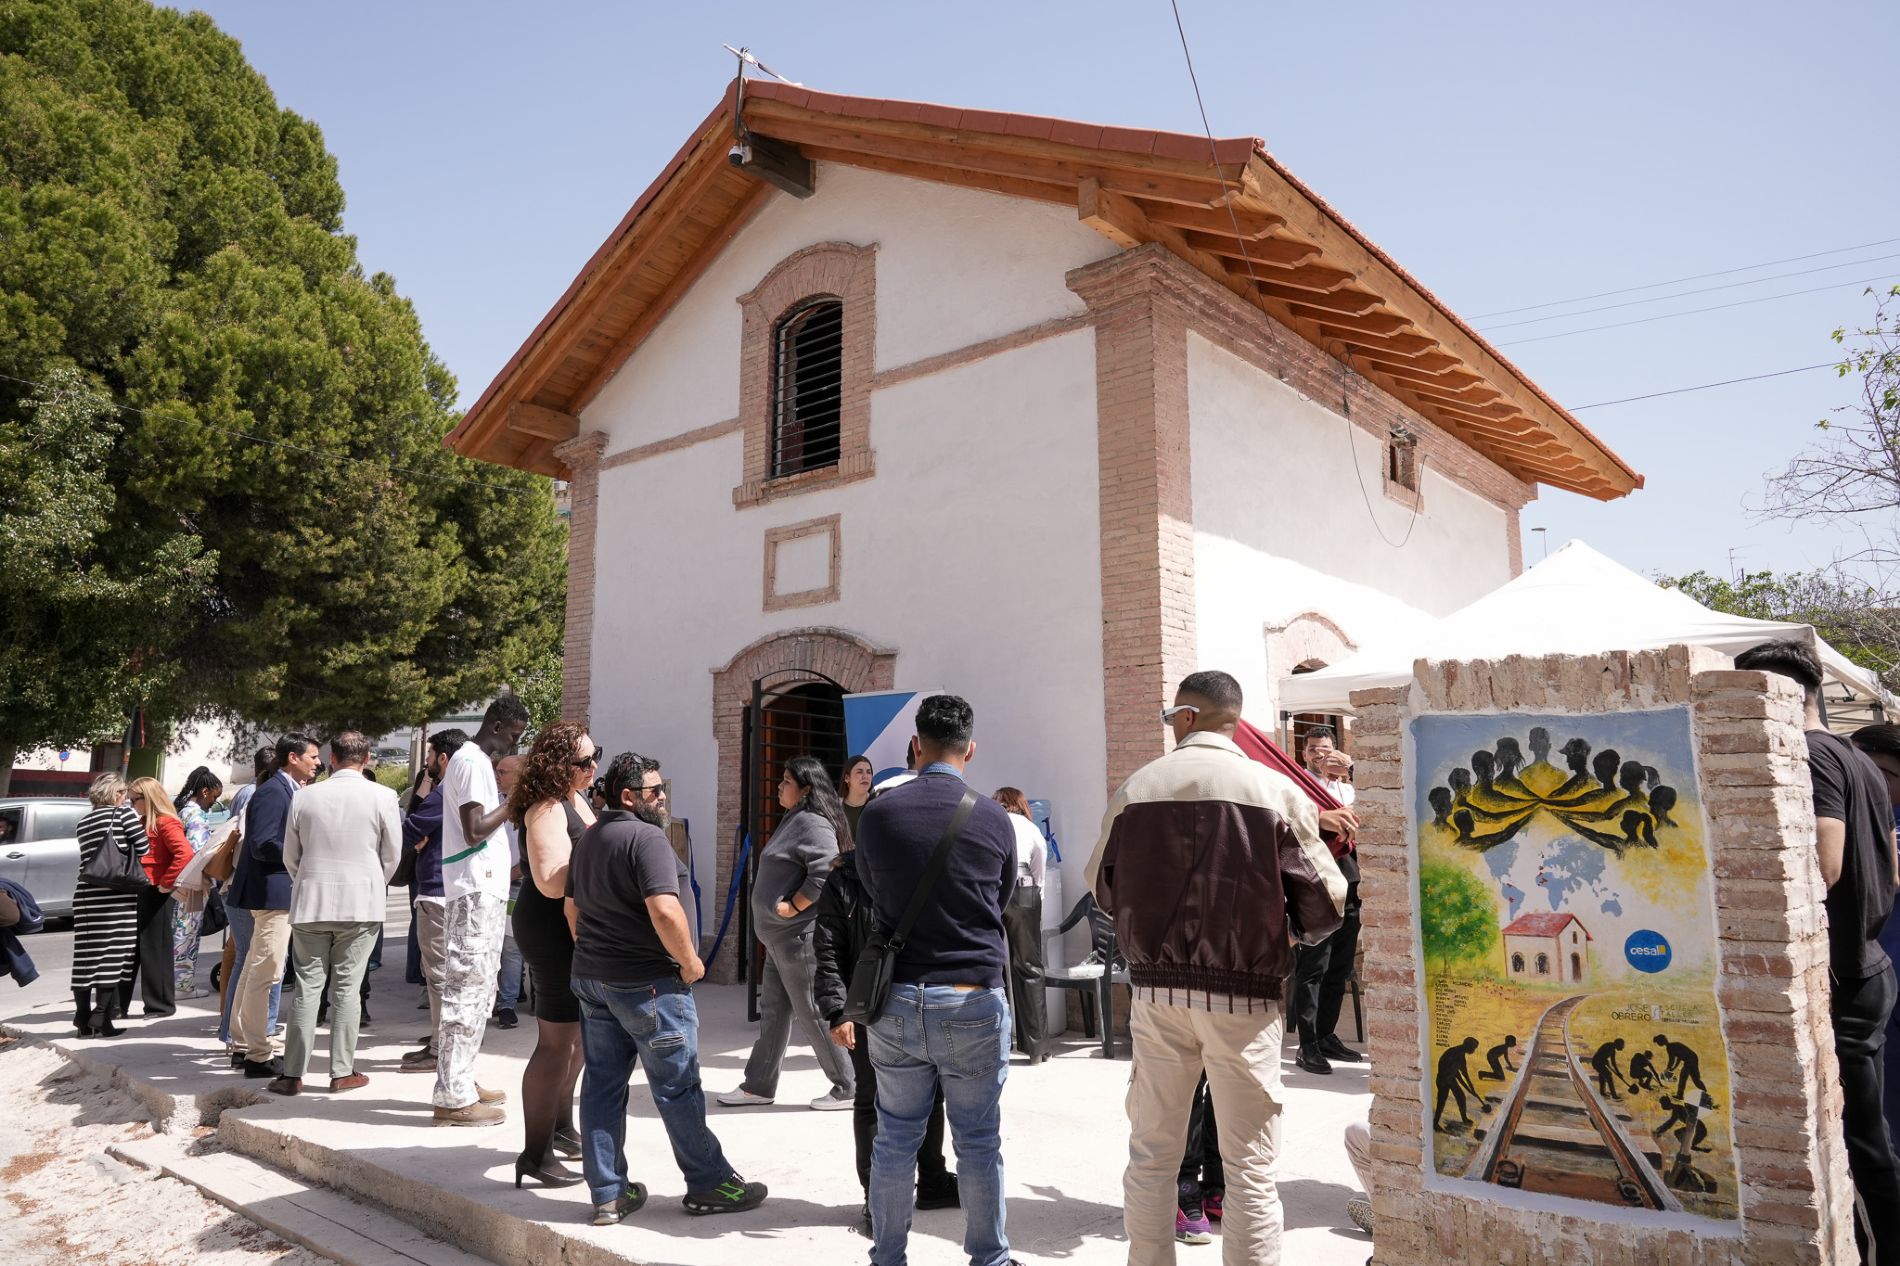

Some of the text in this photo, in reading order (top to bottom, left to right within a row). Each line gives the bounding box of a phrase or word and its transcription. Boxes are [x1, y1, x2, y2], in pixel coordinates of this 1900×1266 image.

[1630, 945, 1660, 956] cesal
[1625, 1003, 1649, 1013] JOSE
[1611, 1011, 1652, 1022] OBRERO
